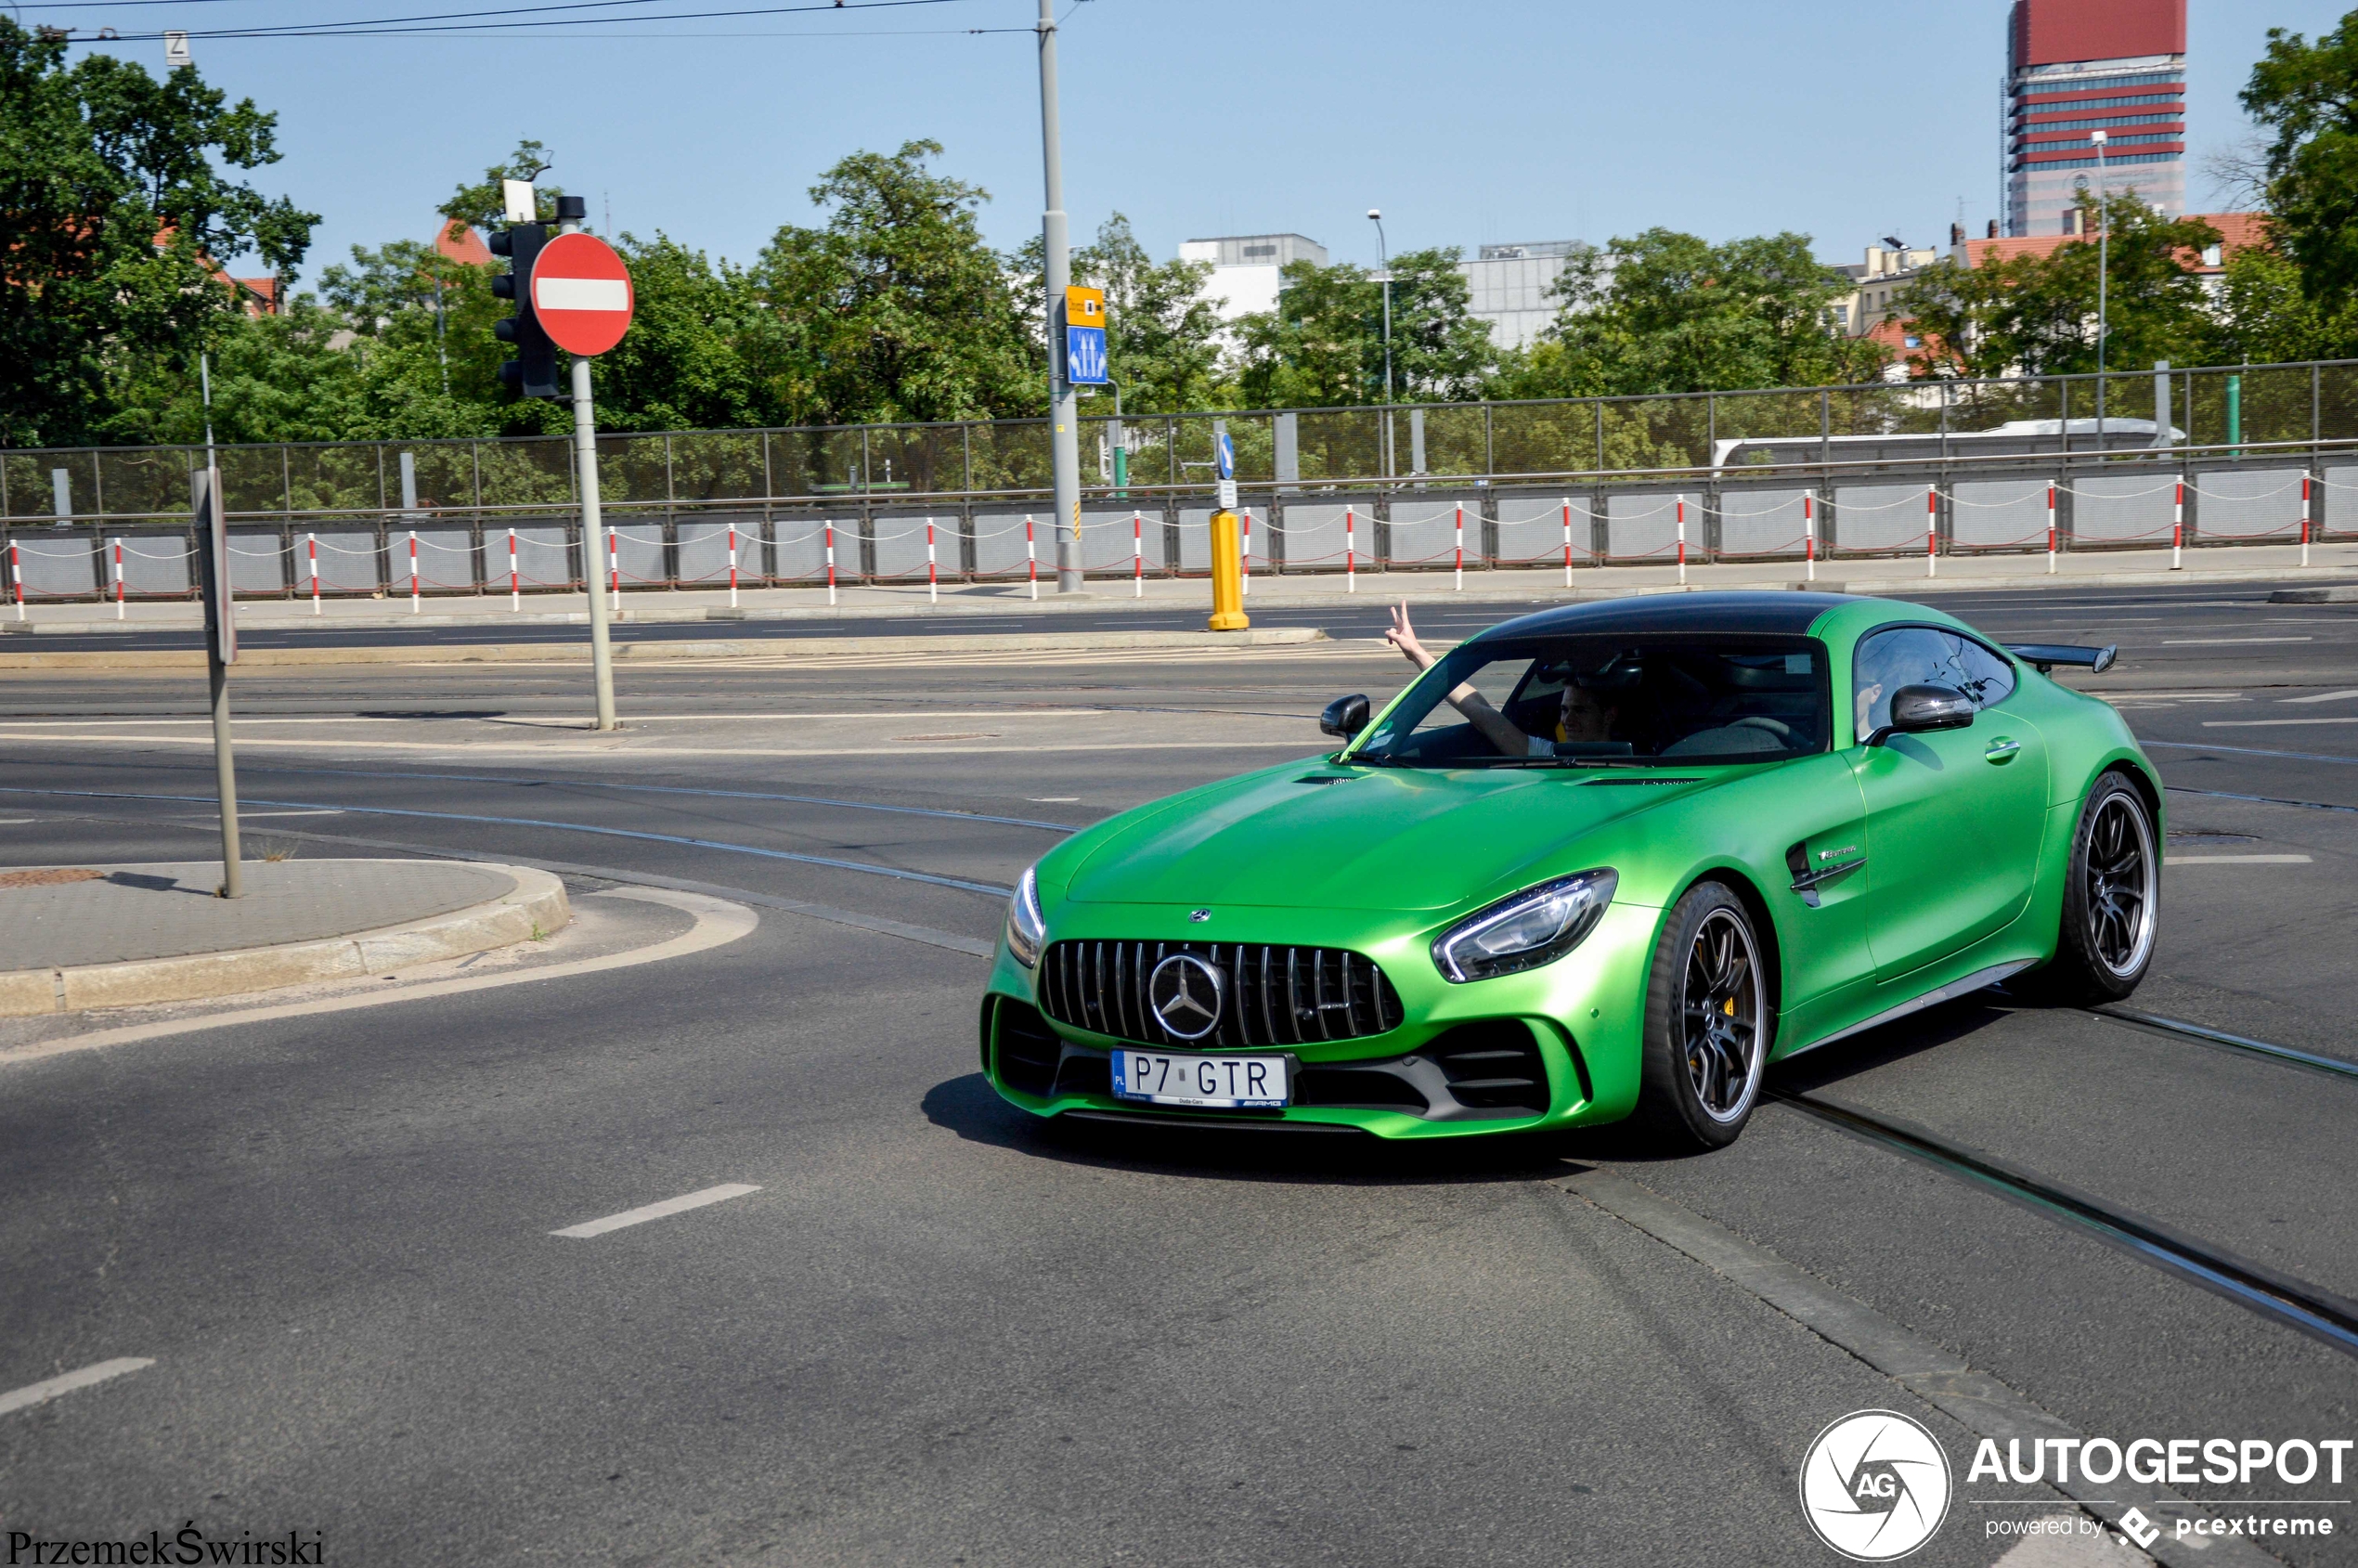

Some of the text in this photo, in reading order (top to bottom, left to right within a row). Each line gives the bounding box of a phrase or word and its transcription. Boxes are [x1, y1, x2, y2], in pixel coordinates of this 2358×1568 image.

[1115, 1075, 1124, 1086] PL
[1135, 1056, 1268, 1095] P7 GTR
